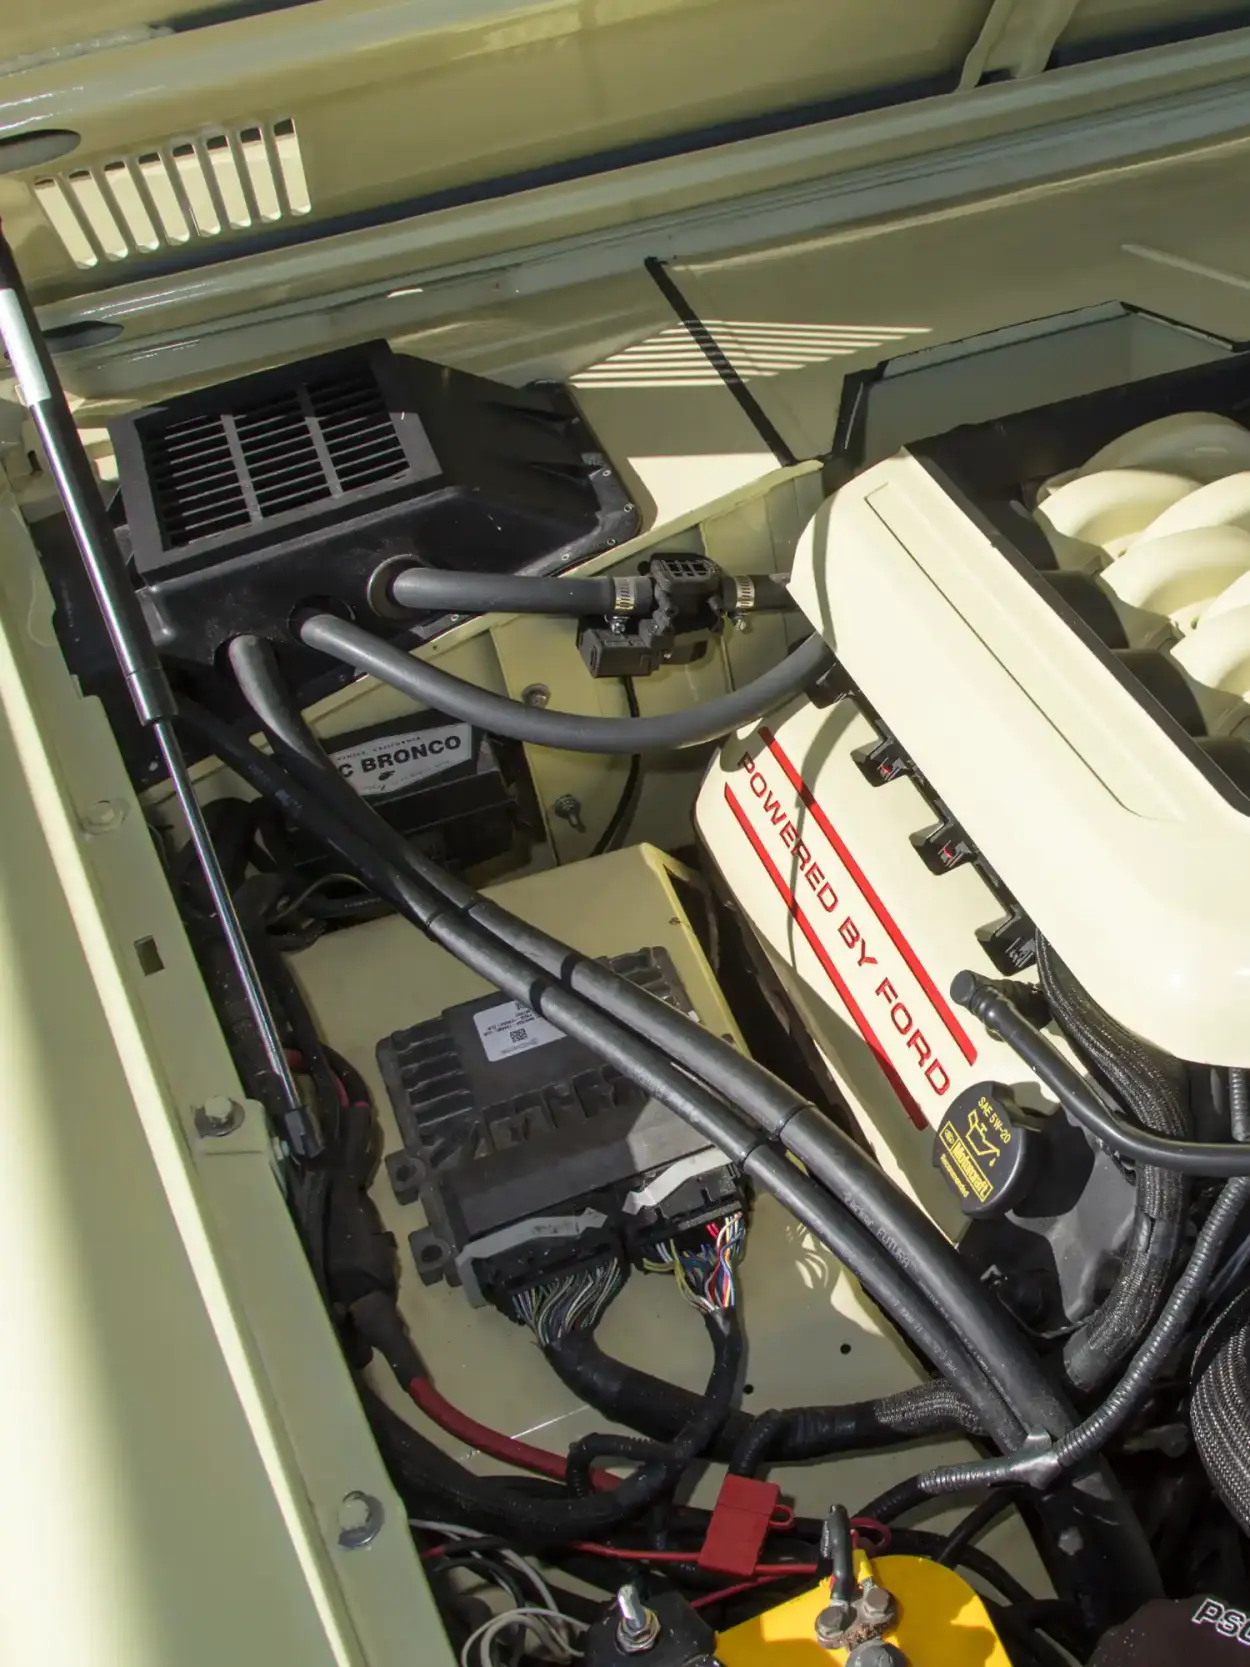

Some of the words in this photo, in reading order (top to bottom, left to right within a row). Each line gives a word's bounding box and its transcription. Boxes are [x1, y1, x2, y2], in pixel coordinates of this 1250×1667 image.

[360, 735, 462, 774] BRONCO
[739, 751, 840, 913] POWERED
[837, 915, 878, 968] BY
[874, 976, 951, 1097] FORD
[978, 1096, 994, 1118] SAE
[989, 1112, 1012, 1144] 5W-20
[951, 1140, 989, 1200] Motorcraft
